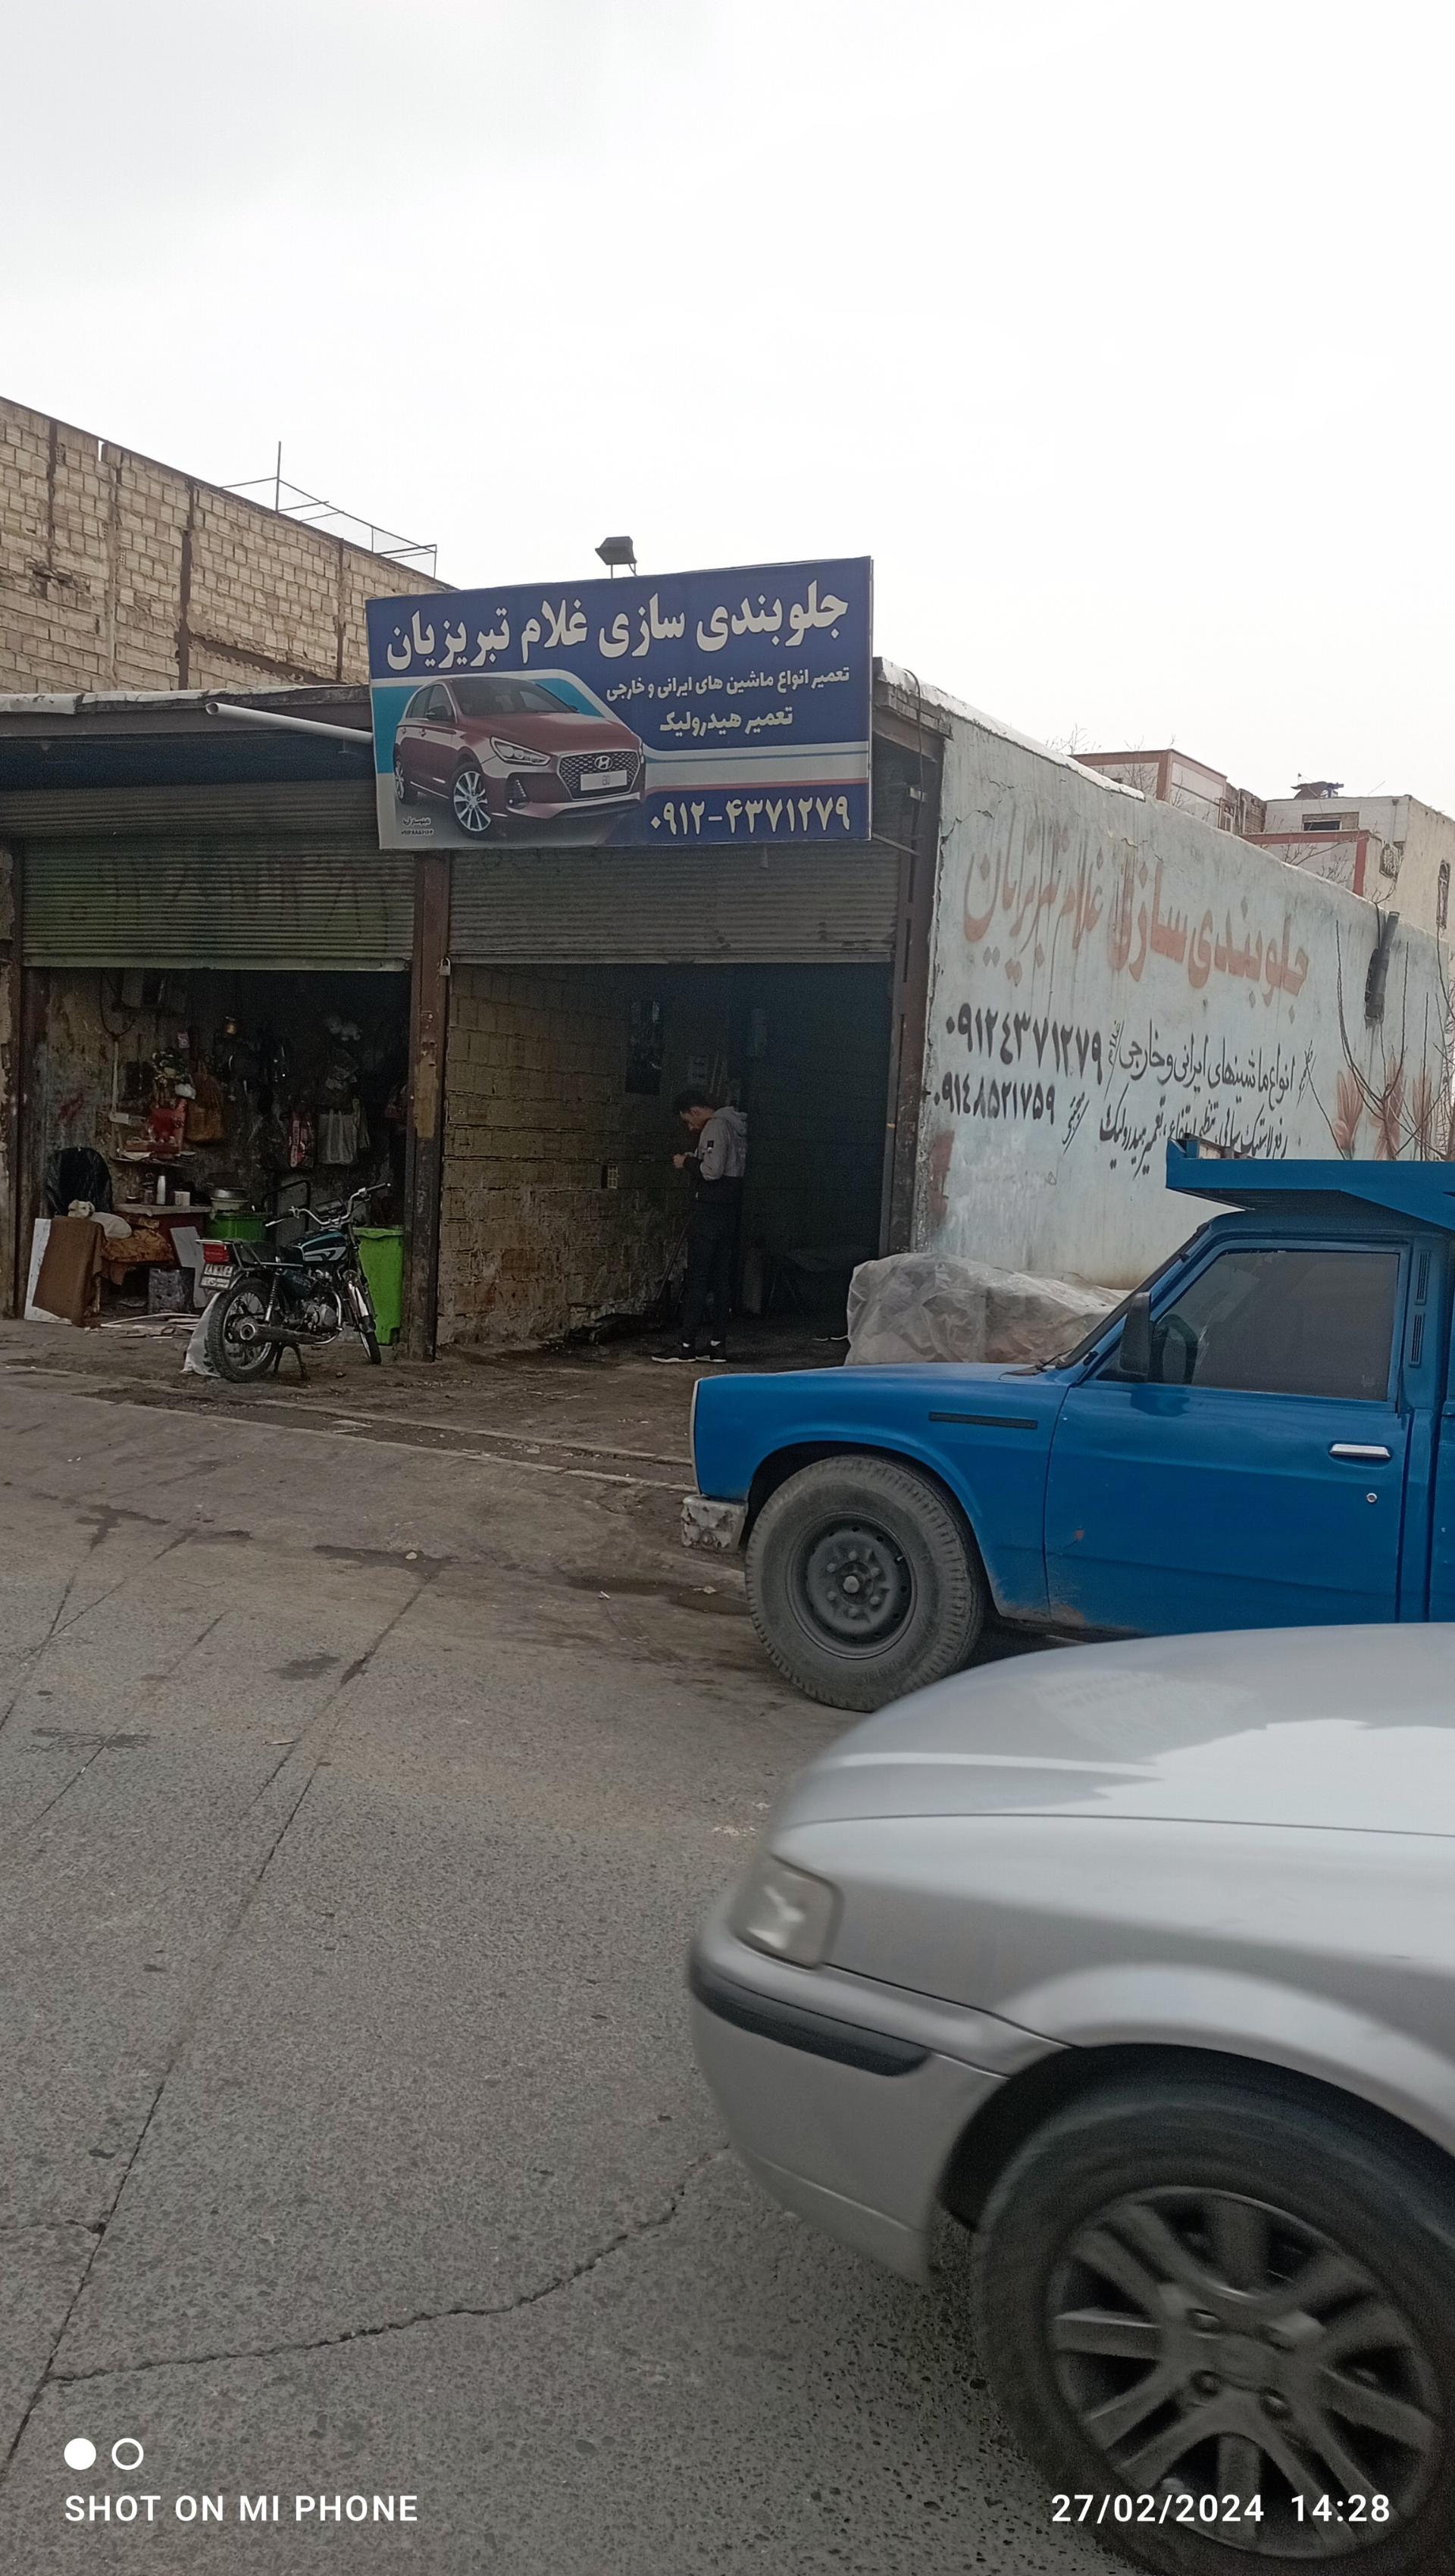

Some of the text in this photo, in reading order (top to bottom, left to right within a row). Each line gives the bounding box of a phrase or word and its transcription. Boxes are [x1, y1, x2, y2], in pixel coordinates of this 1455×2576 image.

[387, 580, 849, 671] جلوبندی سازی غلام تبریزیان
[606, 667, 850, 701] تعمیر انواع ماشین های ایرانی و خارجی
[660, 706, 793, 736] تعمیر هیدرولیک
[1188, 893, 1309, 1024] جلوبندی
[1119, 1018, 1167, 1080] خارجی
[1269, 1043, 1295, 1111] انواع
